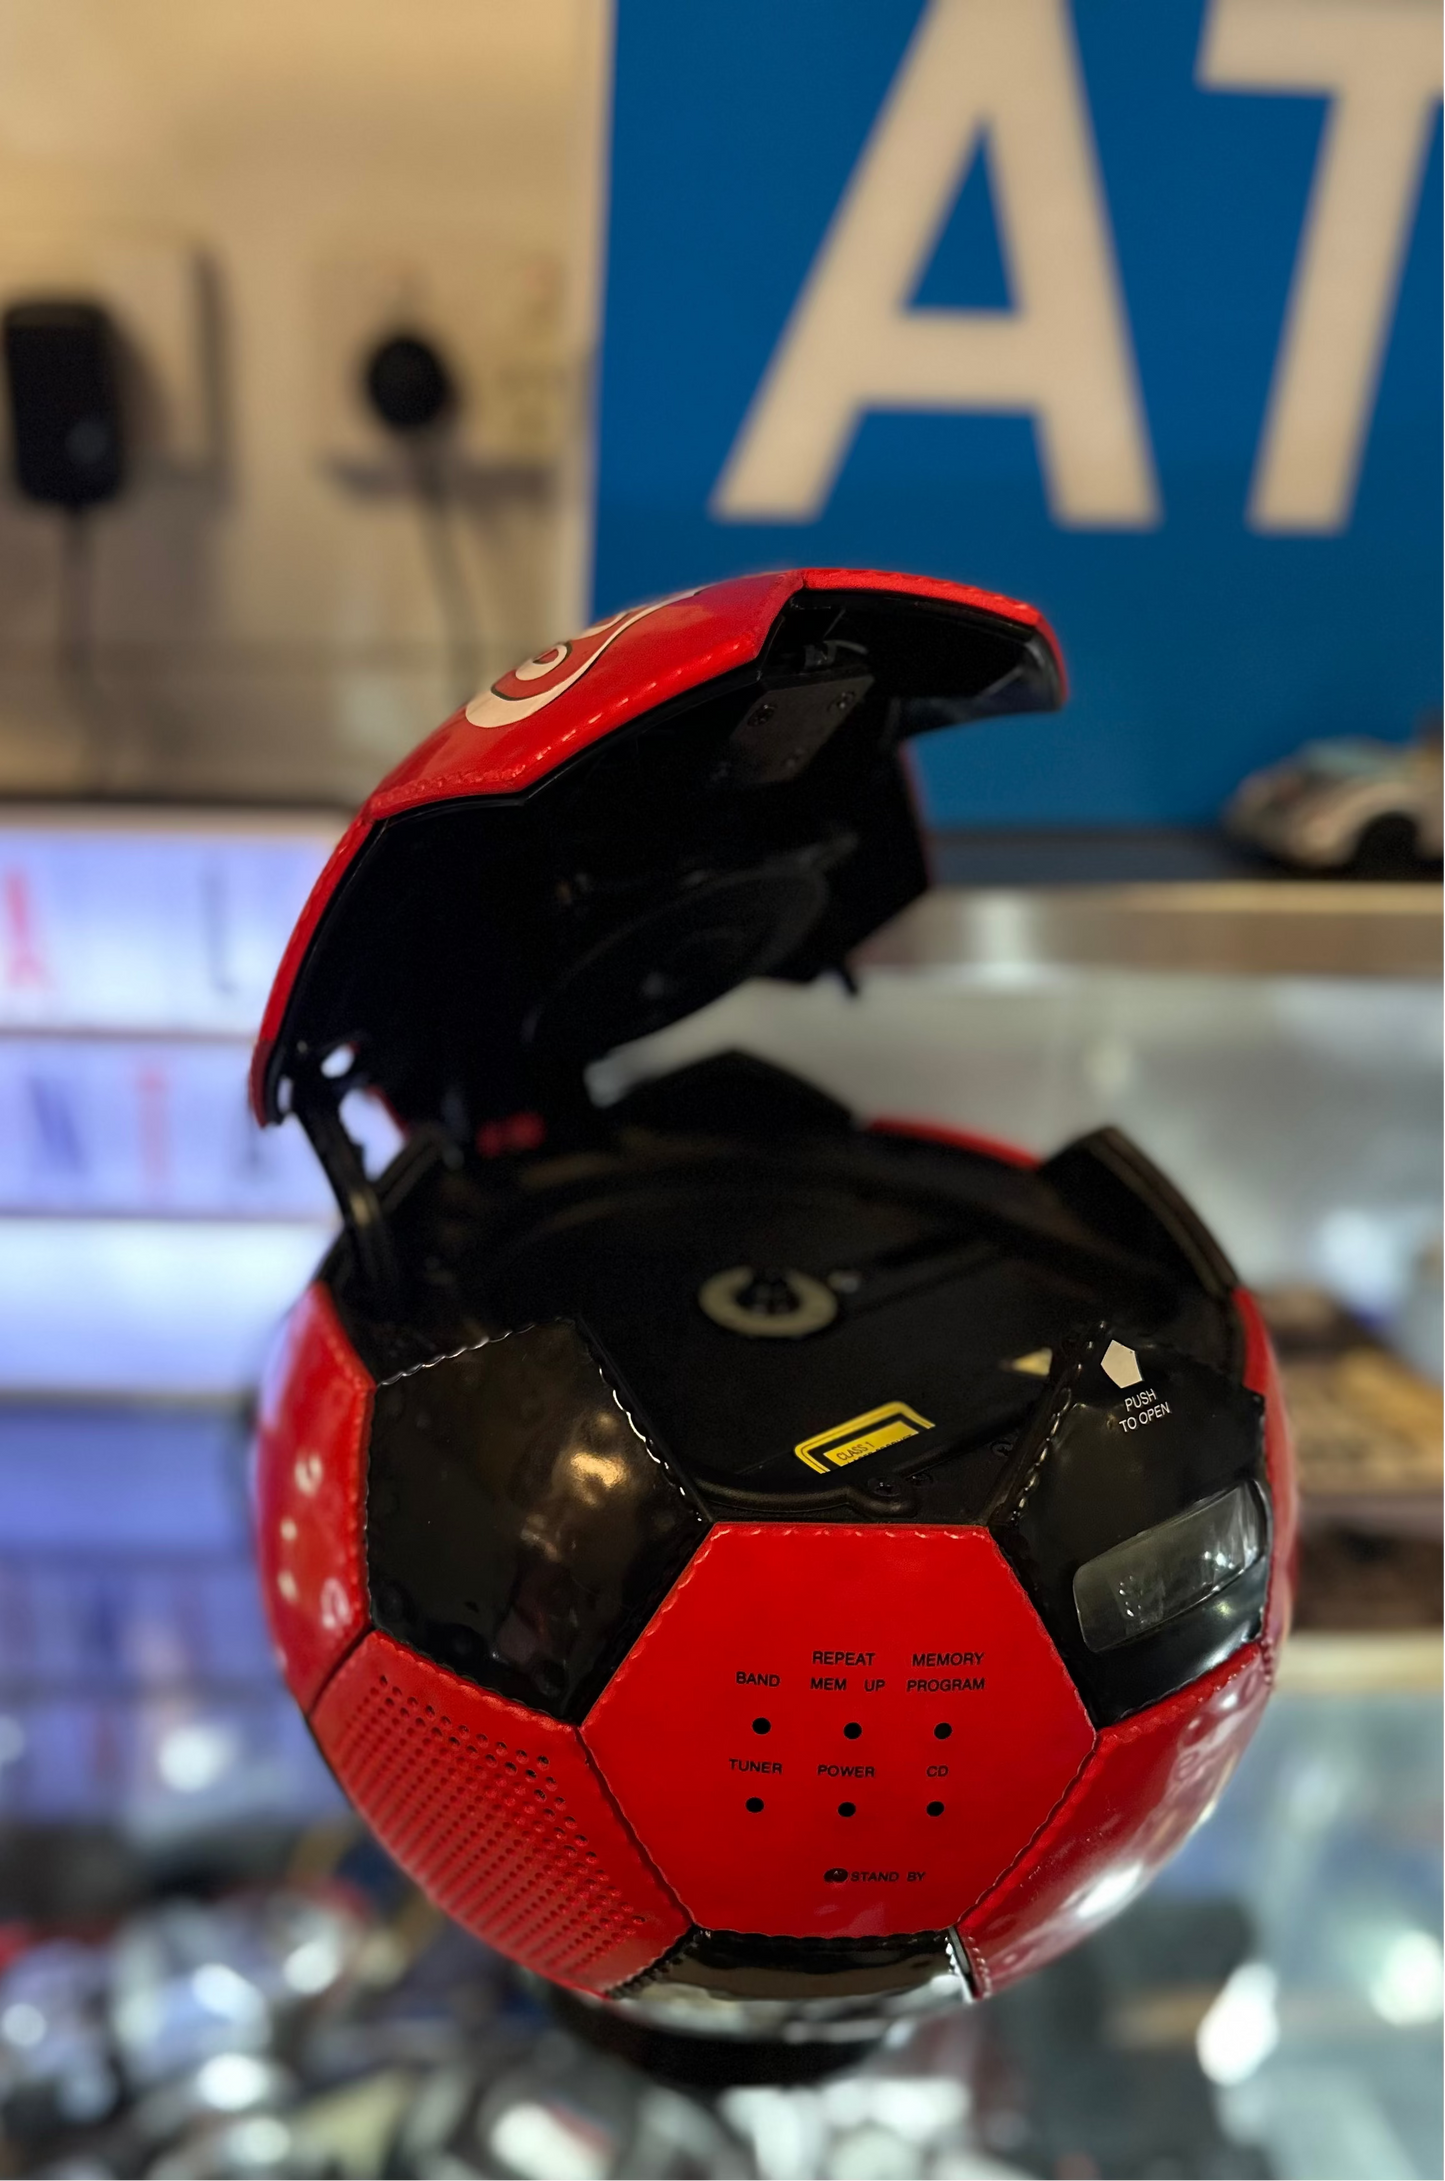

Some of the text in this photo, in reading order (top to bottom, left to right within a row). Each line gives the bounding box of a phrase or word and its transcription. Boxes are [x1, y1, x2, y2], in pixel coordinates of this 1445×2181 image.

[1124, 1388, 1157, 1412] PUSH
[1119, 1401, 1171, 1433] TO OPEN
[836, 1444, 868, 1461] CLASS
[865, 1441, 875, 1449] 1
[812, 1651, 876, 1666] REPEAT
[912, 1652, 984, 1667] MEMORY
[736, 1671, 781, 1687] BAND
[811, 1678, 886, 1693] MEM UP
[906, 1678, 986, 1692] PROGRAM
[729, 1758, 783, 1774] TUNER
[817, 1765, 876, 1779] POWER
[926, 1766, 949, 1778] CD
[850, 1871, 926, 1882] STAND BY
